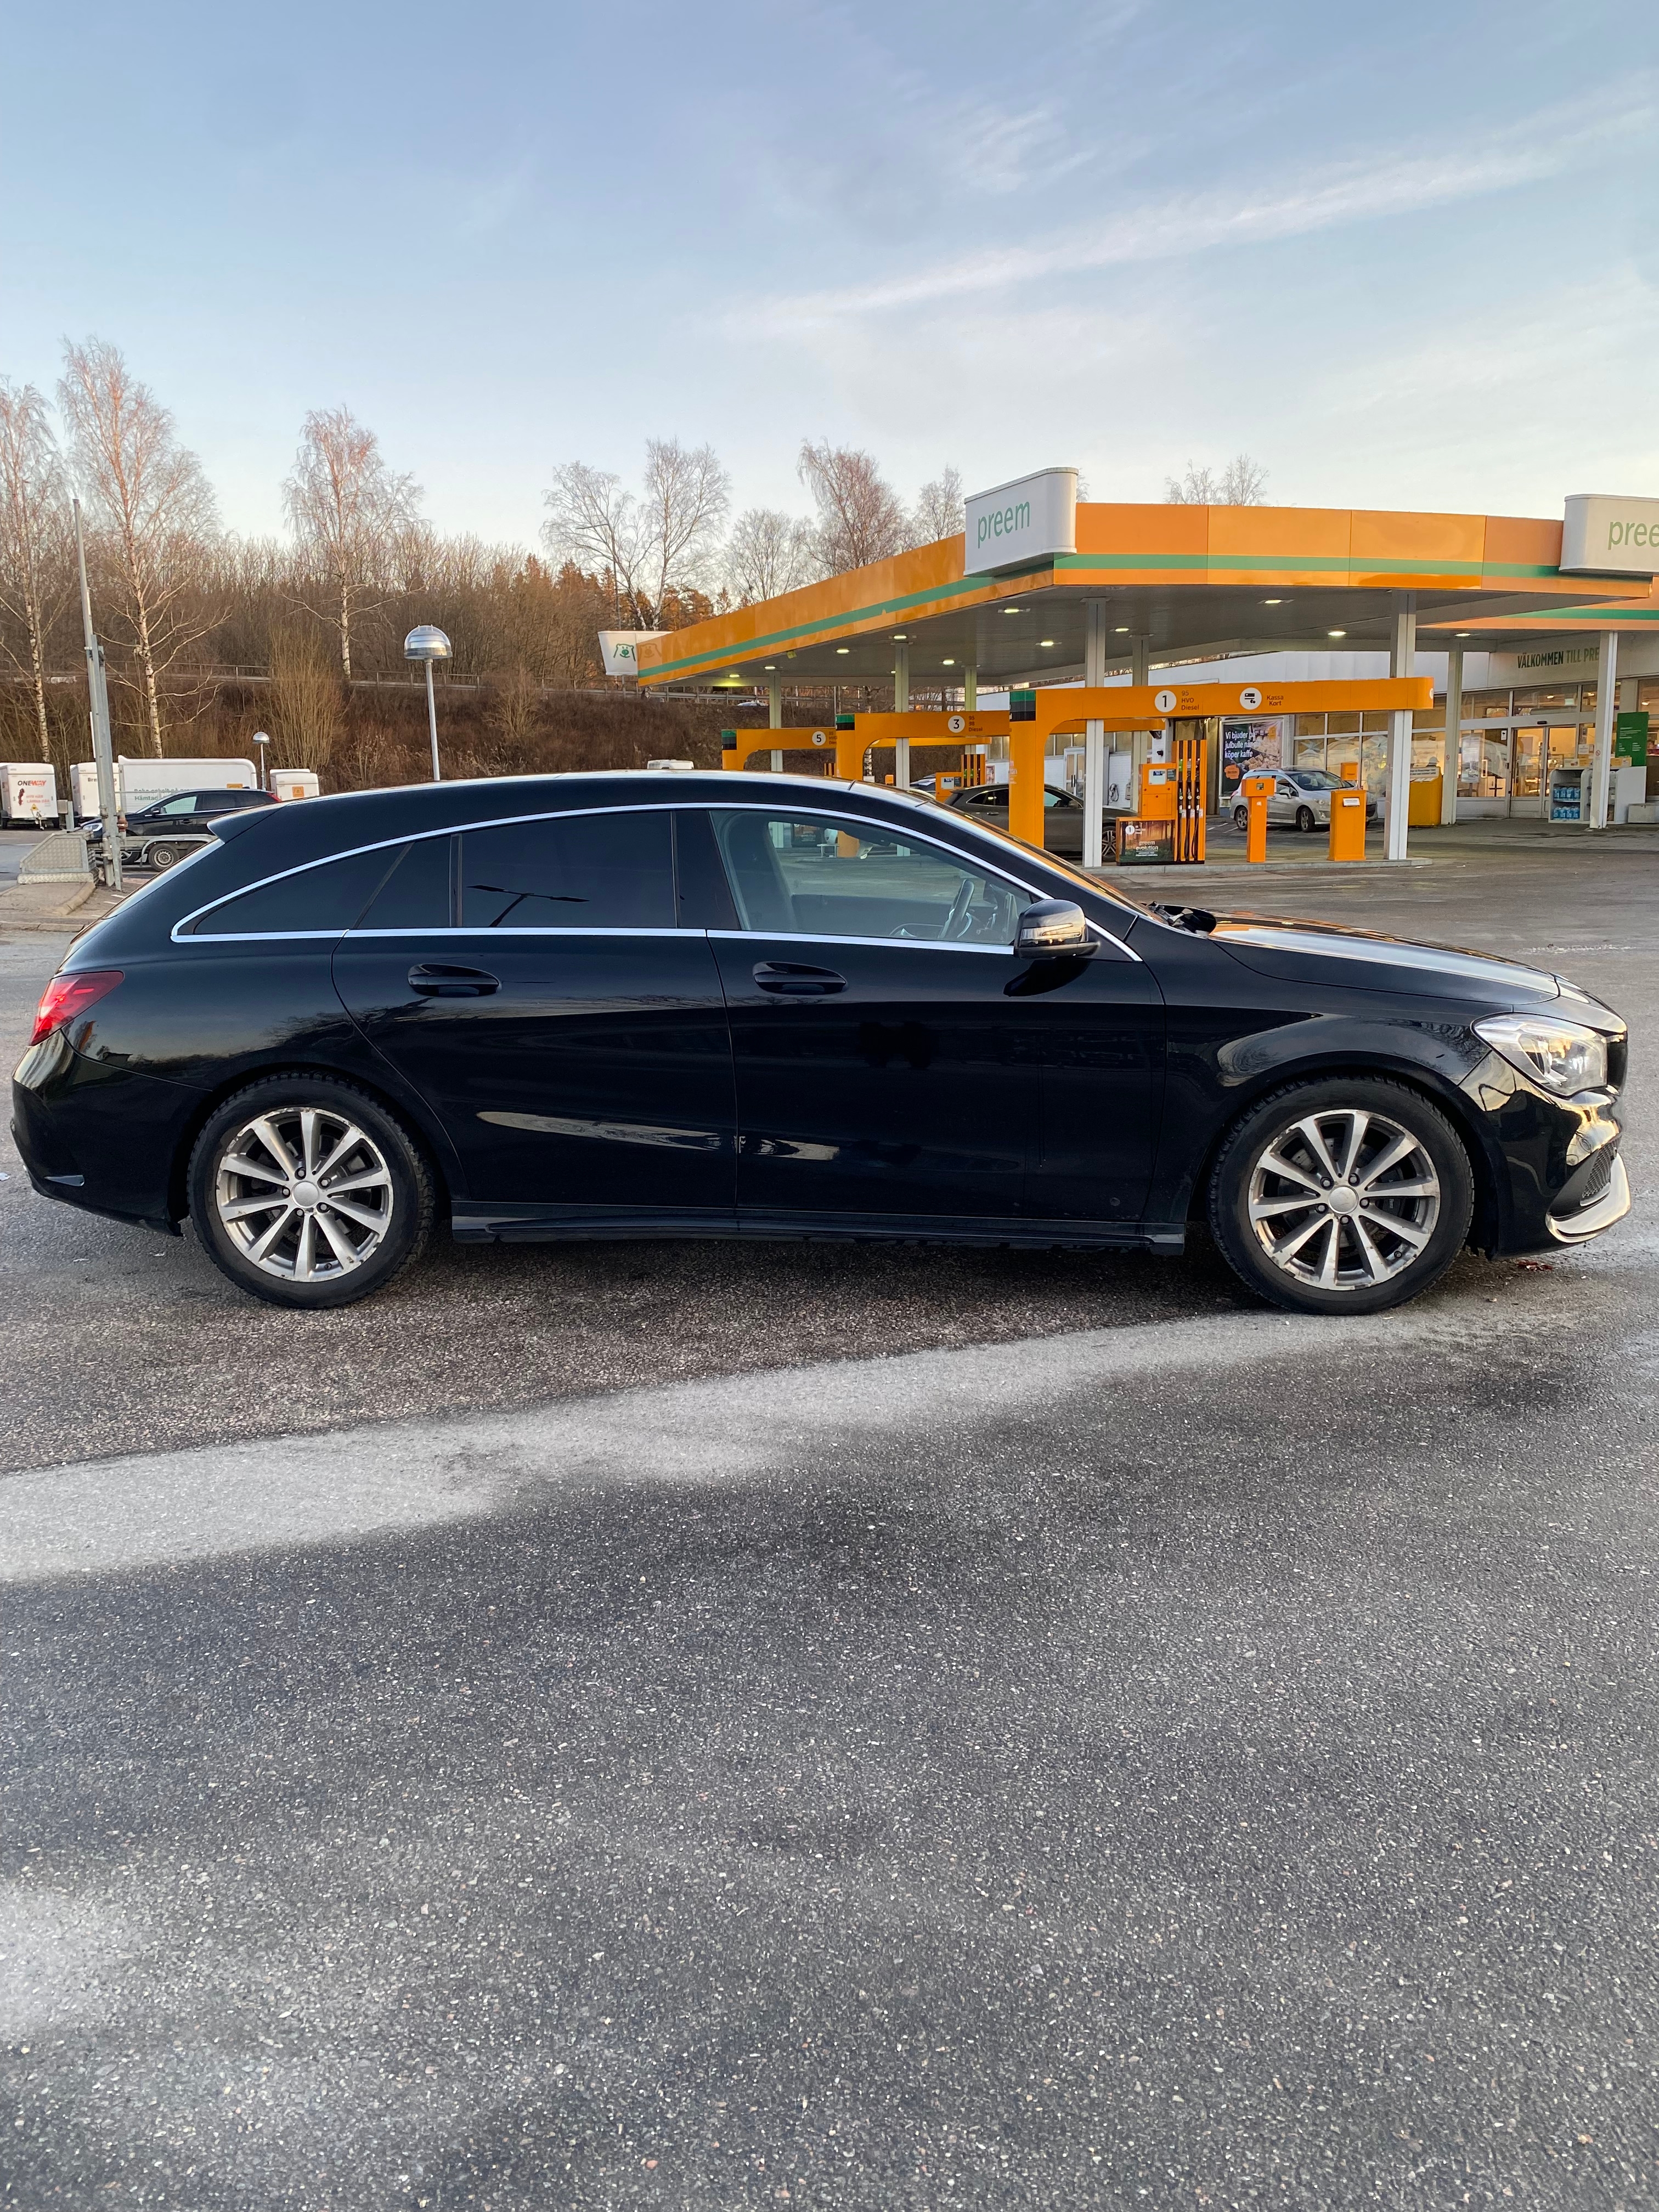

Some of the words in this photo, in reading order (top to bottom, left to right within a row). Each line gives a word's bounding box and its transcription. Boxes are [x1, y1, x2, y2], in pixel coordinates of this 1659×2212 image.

[978, 501, 1030, 549] preem
[1608, 521, 1659, 550] pree
[1517, 651, 1564, 669] VÄLKOMMEN
[1566, 649, 1581, 664] TILL
[1584, 647, 1600, 662] PRE
[1162, 695, 1167, 708] 1
[953, 719, 960, 729] 3
[816, 733, 822, 743] 5
[1225, 731, 1231, 740] Vi
[1232, 731, 1248, 741] bjuder
[1224, 741, 1243, 750] julbulle
[1224, 750, 1239, 760] köper
[1240, 749, 1253, 758] kaffe
